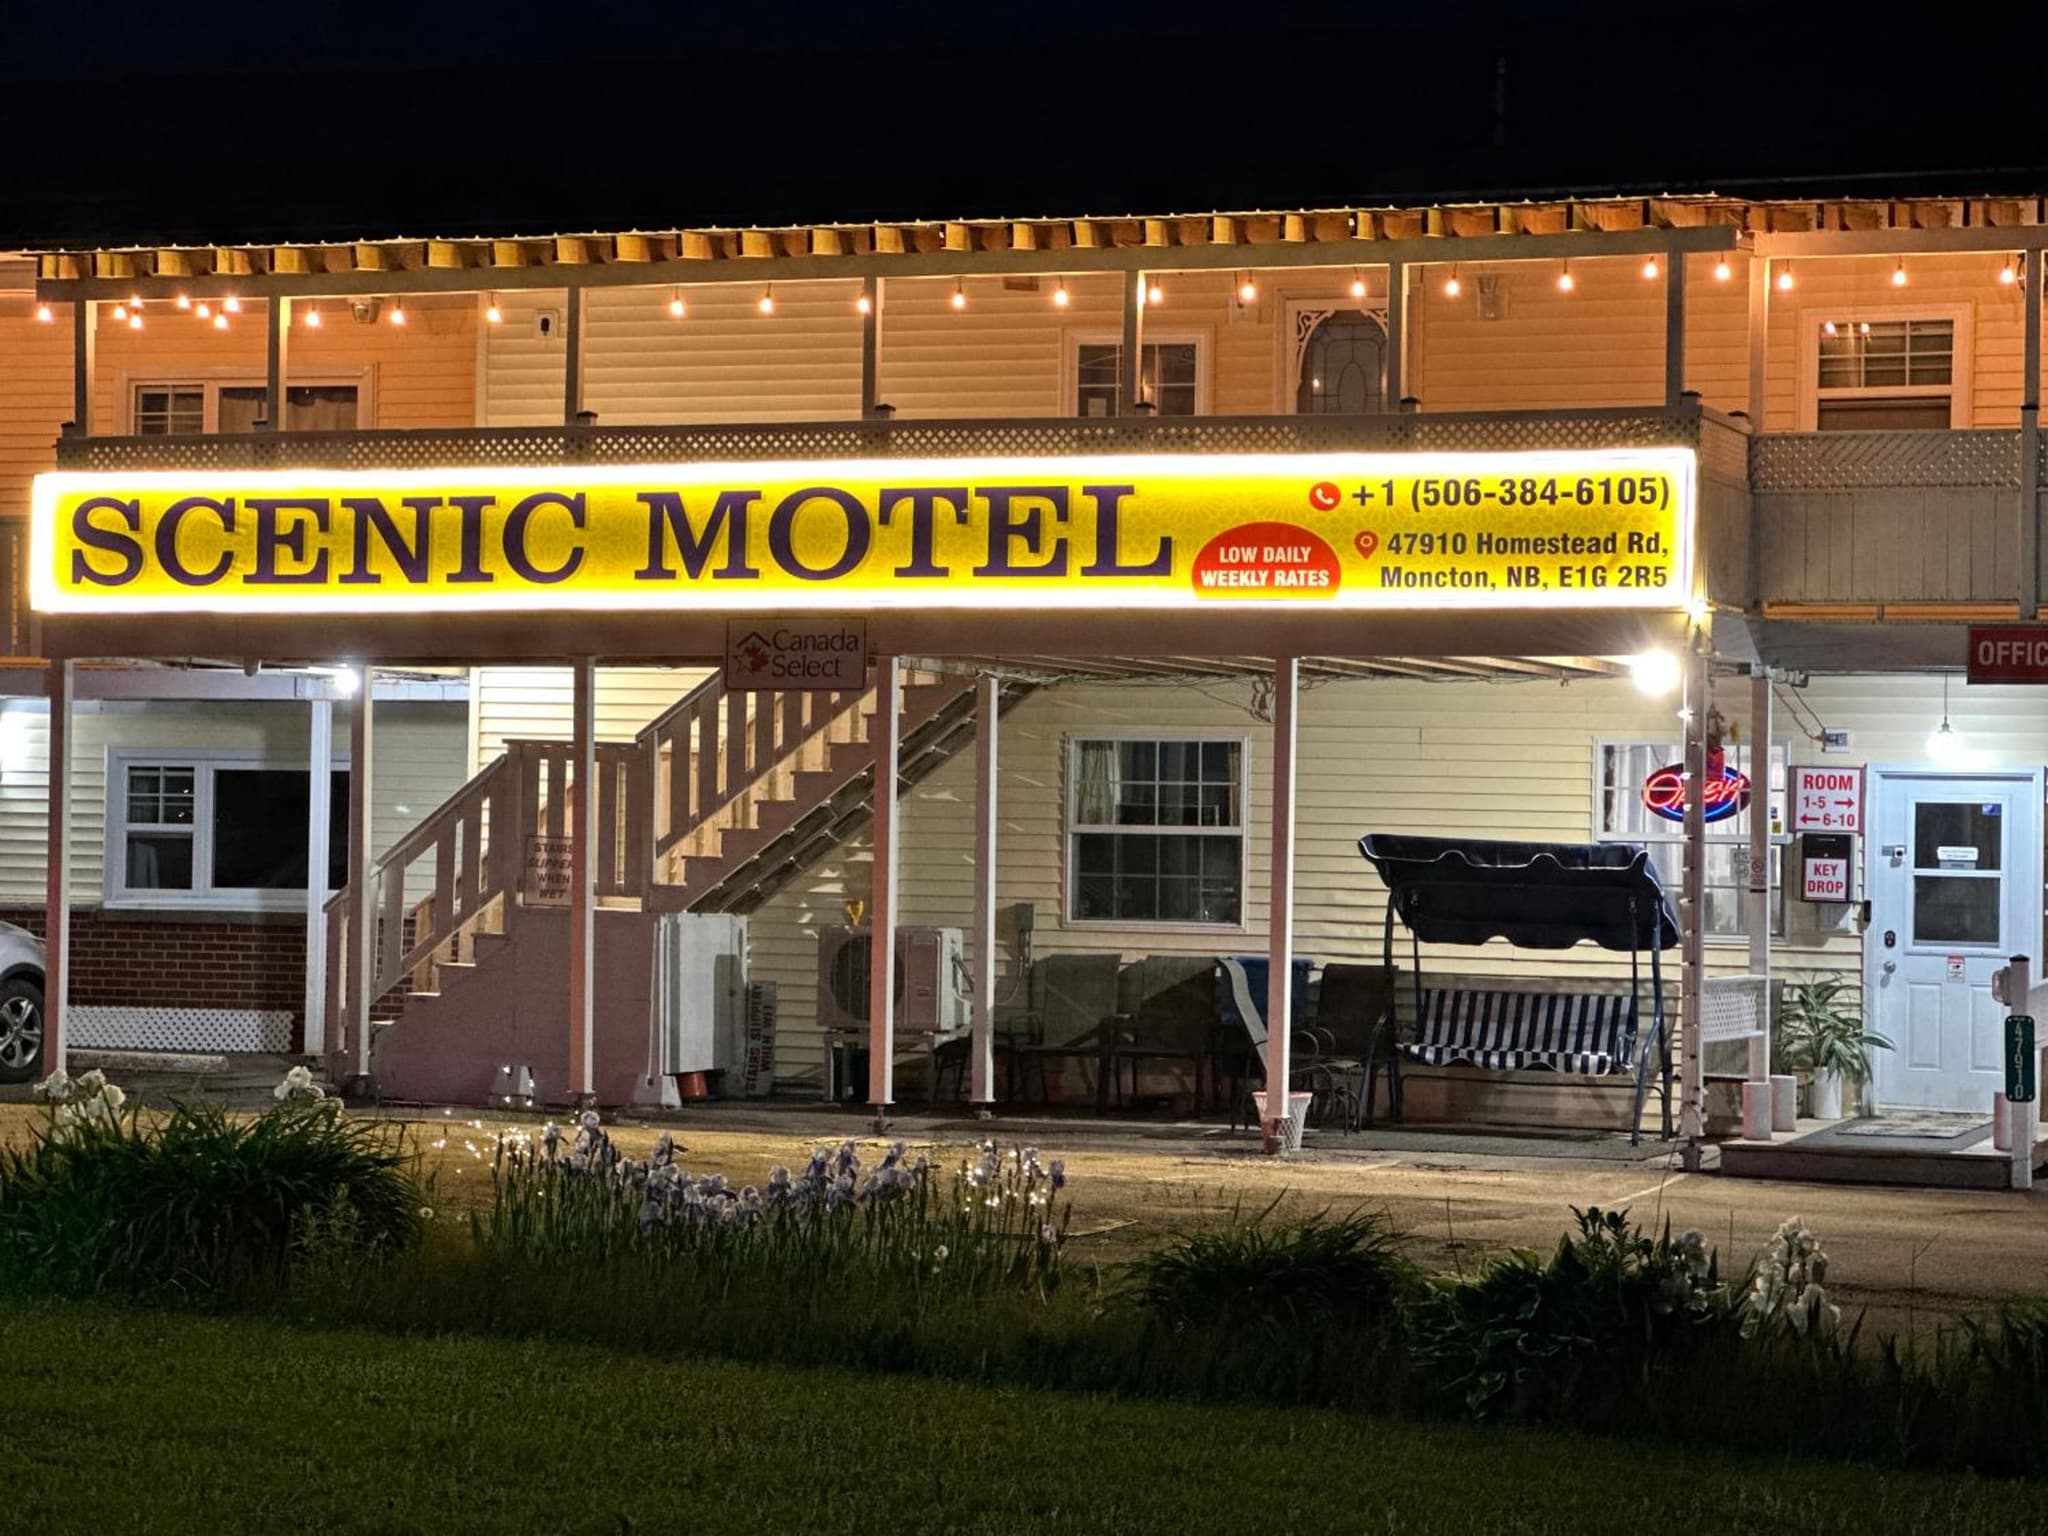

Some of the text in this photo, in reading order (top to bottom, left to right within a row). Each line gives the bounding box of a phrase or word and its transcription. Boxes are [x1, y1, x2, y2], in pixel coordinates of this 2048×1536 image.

[1352, 477, 1670, 512] +1 (506-384-6105)
[71, 485, 1173, 586] SCENIC MOTEL
[1387, 531, 1668, 557] 47910 Homestead Rd,
[1219, 546, 1312, 564] LOW DAILY
[1201, 569, 1330, 587] WEEKLY RATES
[1380, 565, 1668, 592] Moncton, NB, E1G 2R5
[772, 627, 860, 652] Canada
[1978, 640, 2048, 666] OFFIC
[771, 654, 841, 678] Select
[1803, 774, 1854, 791] ROOM
[1803, 796, 1826, 809] 1-5
[1822, 813, 1856, 827] 6-10
[534, 842, 576, 854] STAIRS
[527, 857, 577, 870] SLIPPER
[1813, 863, 1839, 877] KEY
[536, 872, 571, 884] WHEN
[1807, 880, 1844, 894] DROP
